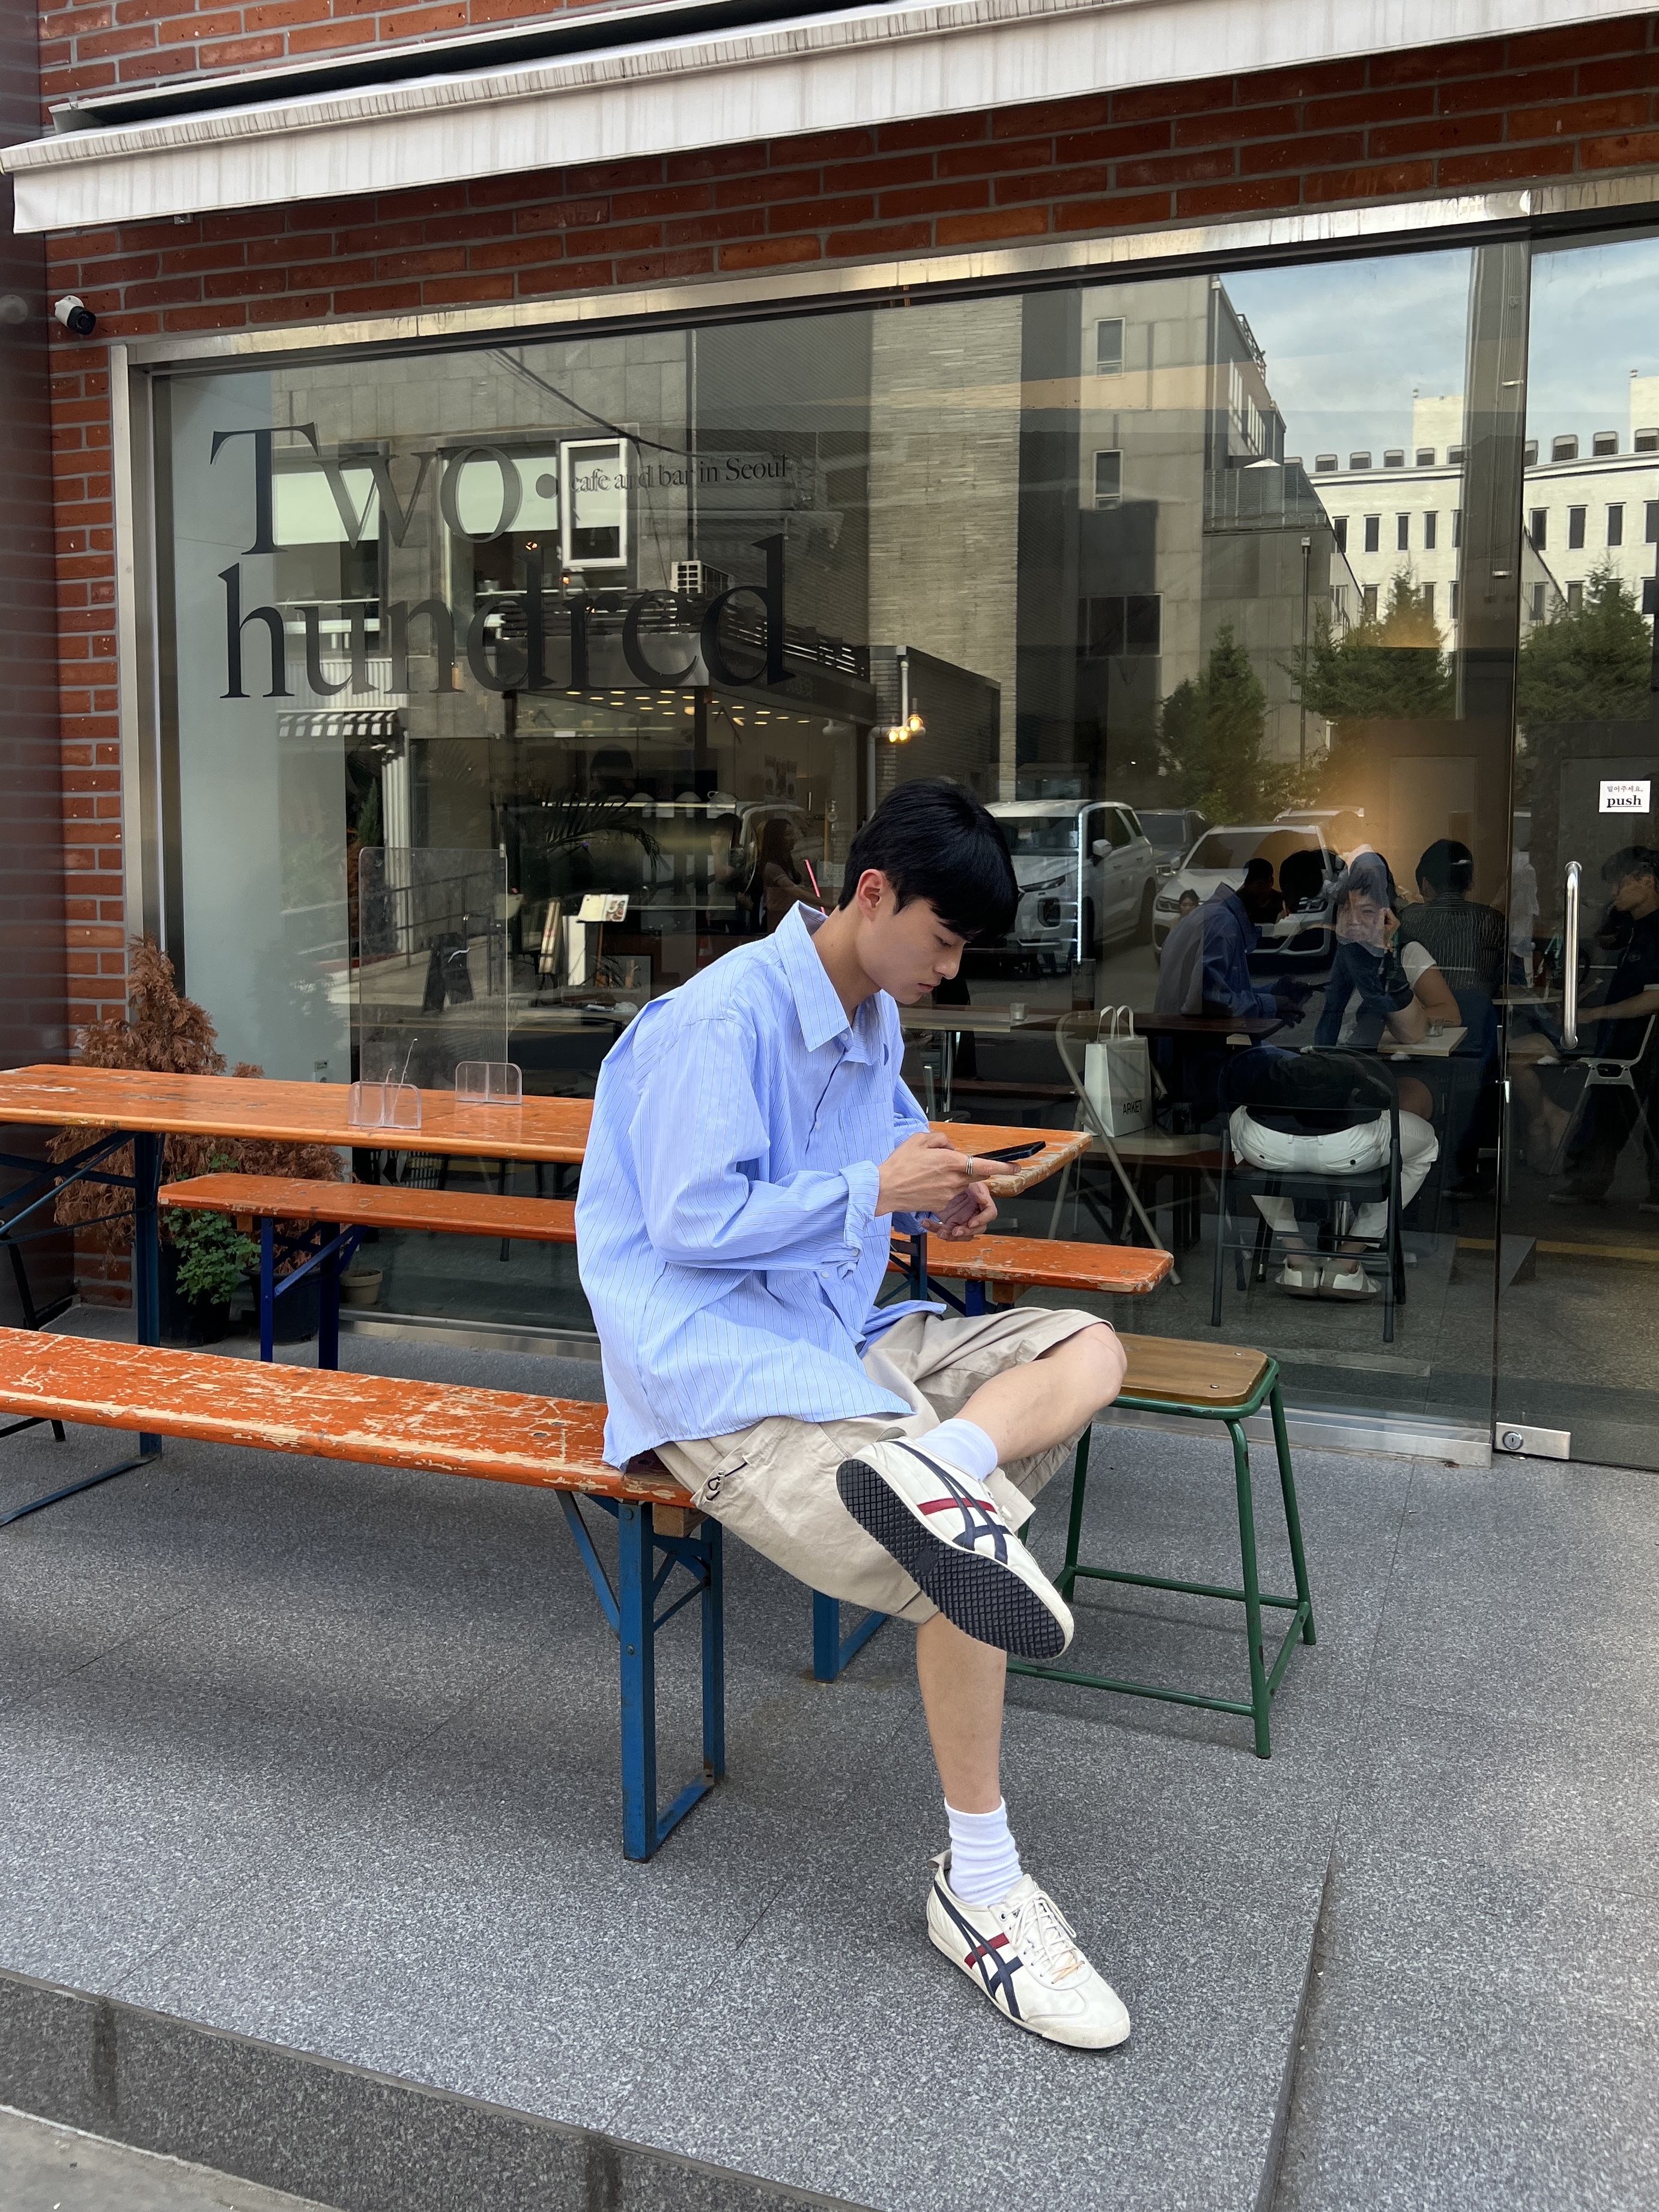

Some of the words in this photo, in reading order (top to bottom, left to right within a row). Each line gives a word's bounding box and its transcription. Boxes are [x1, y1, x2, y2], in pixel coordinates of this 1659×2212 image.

[210, 422, 523, 555] Two
[571, 468, 610, 492] cafe
[614, 465, 653, 490] and
[658, 464, 693, 487] bar
[700, 461, 718, 483] in
[725, 454, 787, 481] Seoul
[218, 533, 795, 699] hundred
[1606, 795, 1642, 808] push
[1122, 1100, 1142, 1115] ARKET
